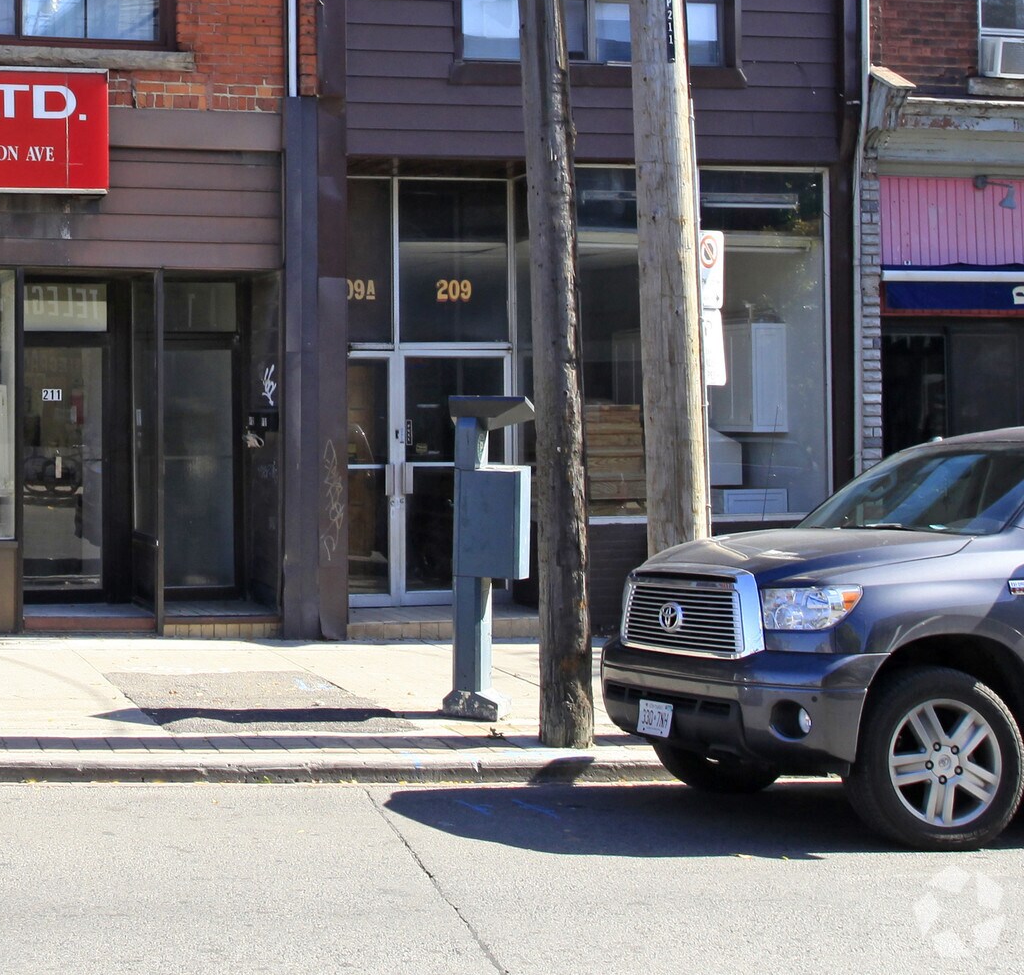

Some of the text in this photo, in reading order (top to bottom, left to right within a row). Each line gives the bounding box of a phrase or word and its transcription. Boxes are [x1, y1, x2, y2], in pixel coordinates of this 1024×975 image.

[25, 146, 55, 163] AVE
[347, 279, 376, 300] 09A
[436, 279, 472, 302] 209
[42, 389, 62, 401] 211
